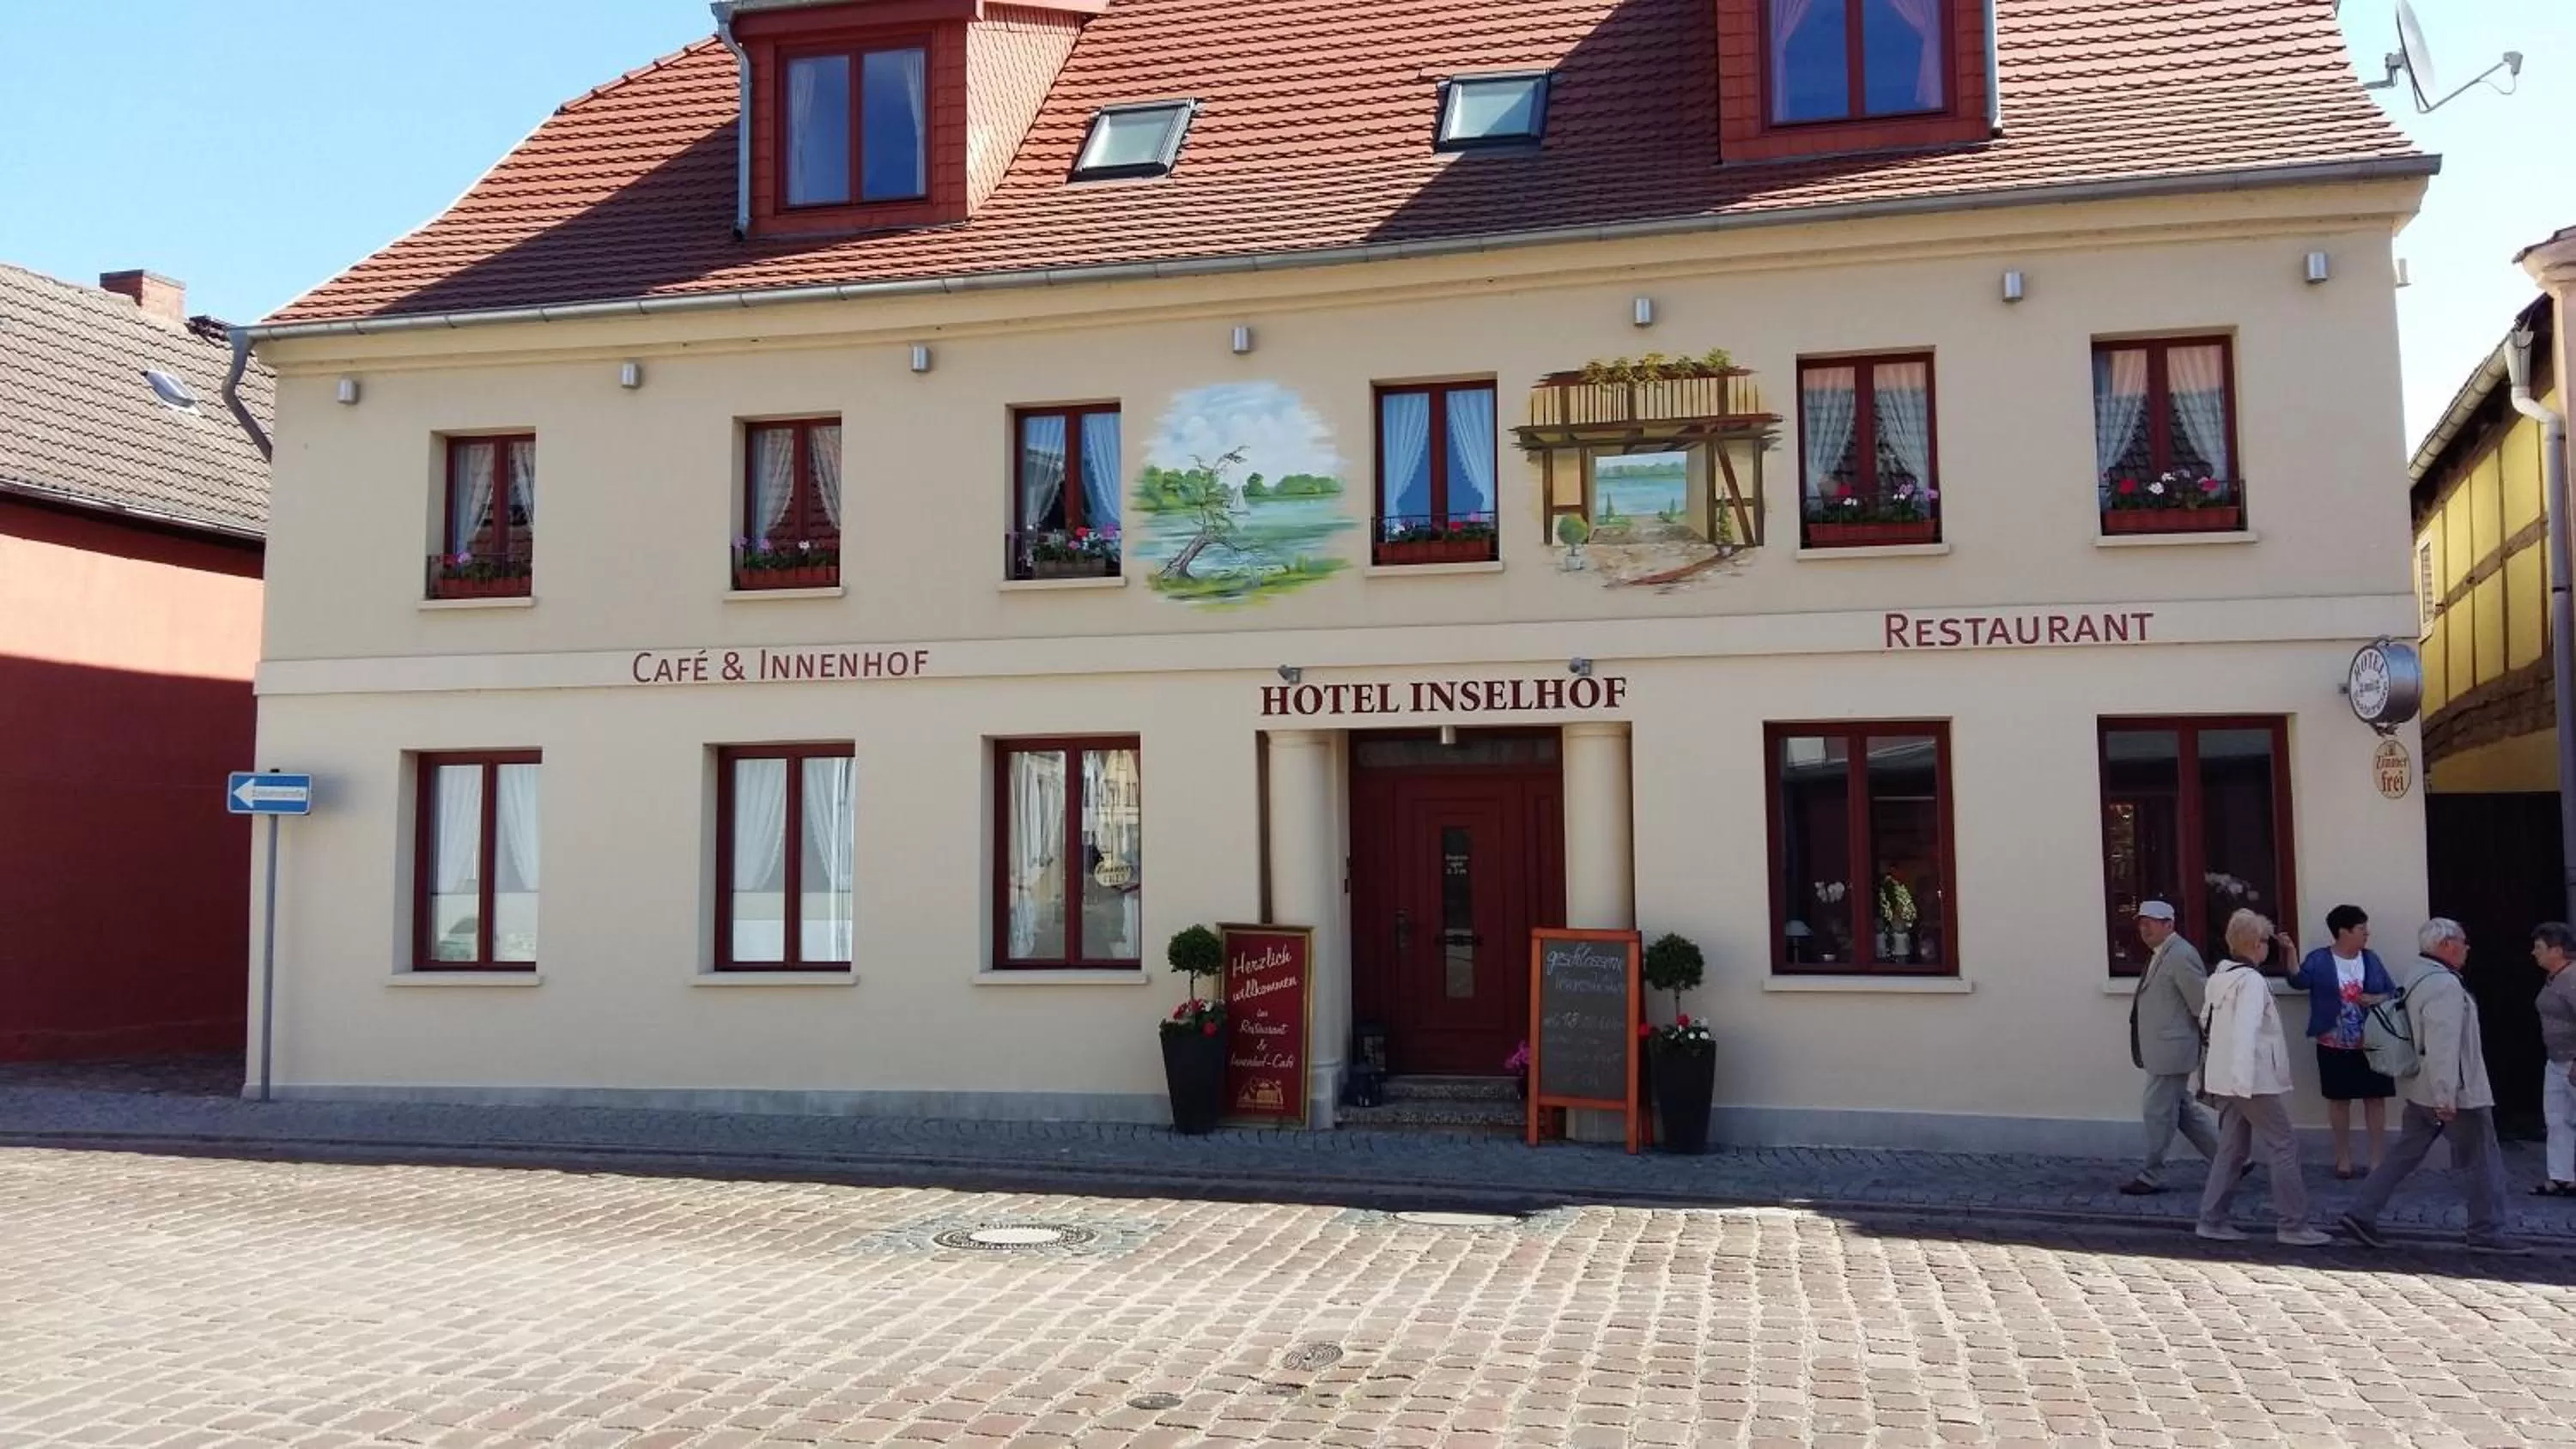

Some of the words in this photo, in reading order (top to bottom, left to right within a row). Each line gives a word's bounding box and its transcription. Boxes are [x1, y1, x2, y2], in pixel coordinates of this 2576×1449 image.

[1884, 612, 2154, 648] RESTAURANT
[632, 649, 709, 683] CAFÉ
[720, 651, 745, 682] &
[760, 648, 930, 680] INNENHOF
[1260, 682, 1400, 716] HOTEL
[1409, 676, 1627, 712] INSELHOF
[2380, 771, 2405, 792] frei
[1232, 944, 1292, 979] Herzlich
[1232, 975, 1298, 1003] willkommen
